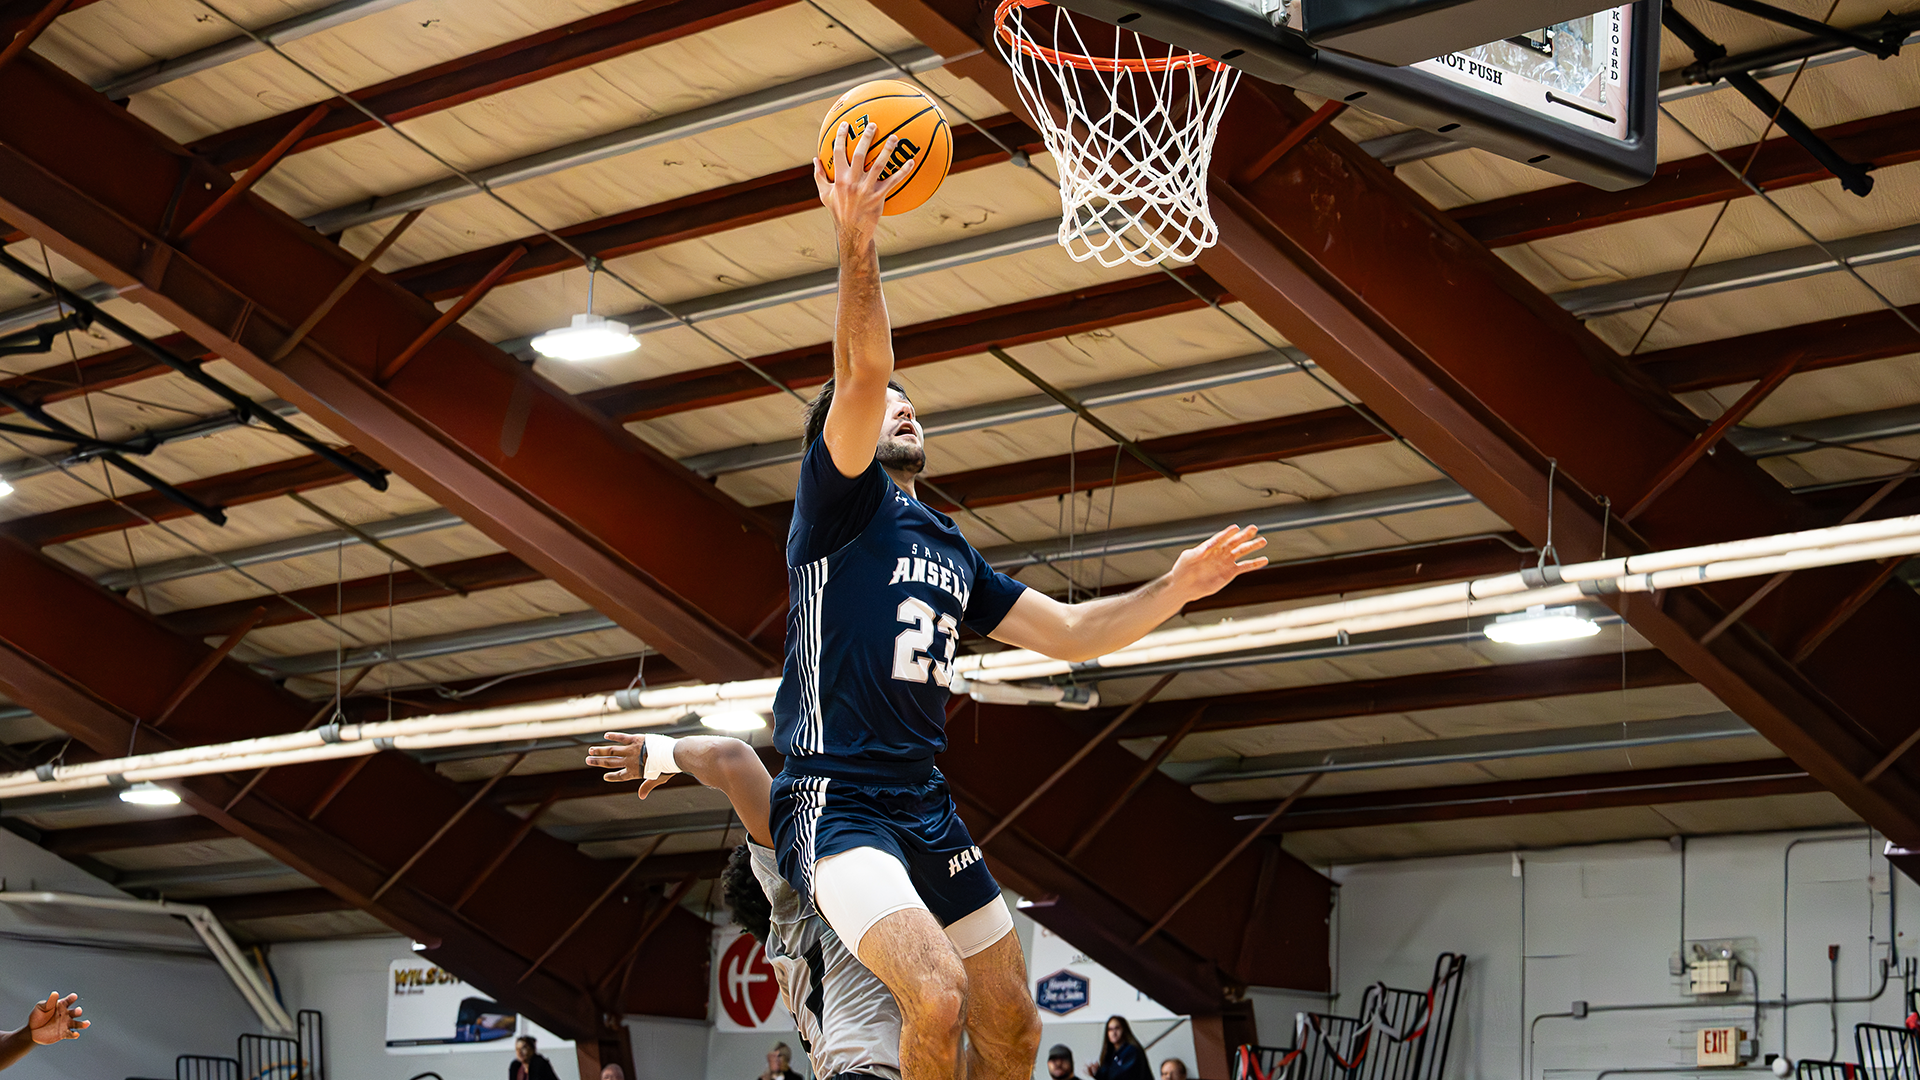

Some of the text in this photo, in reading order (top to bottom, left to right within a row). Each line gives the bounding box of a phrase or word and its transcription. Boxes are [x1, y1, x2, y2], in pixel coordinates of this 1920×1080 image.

[1611, 5, 1620, 80] KBOARD
[1469, 61, 1503, 86] PUSH
[911, 543, 966, 580] SAINT
[891, 596, 959, 689] 23
[1704, 1030, 1728, 1054] EXIT
